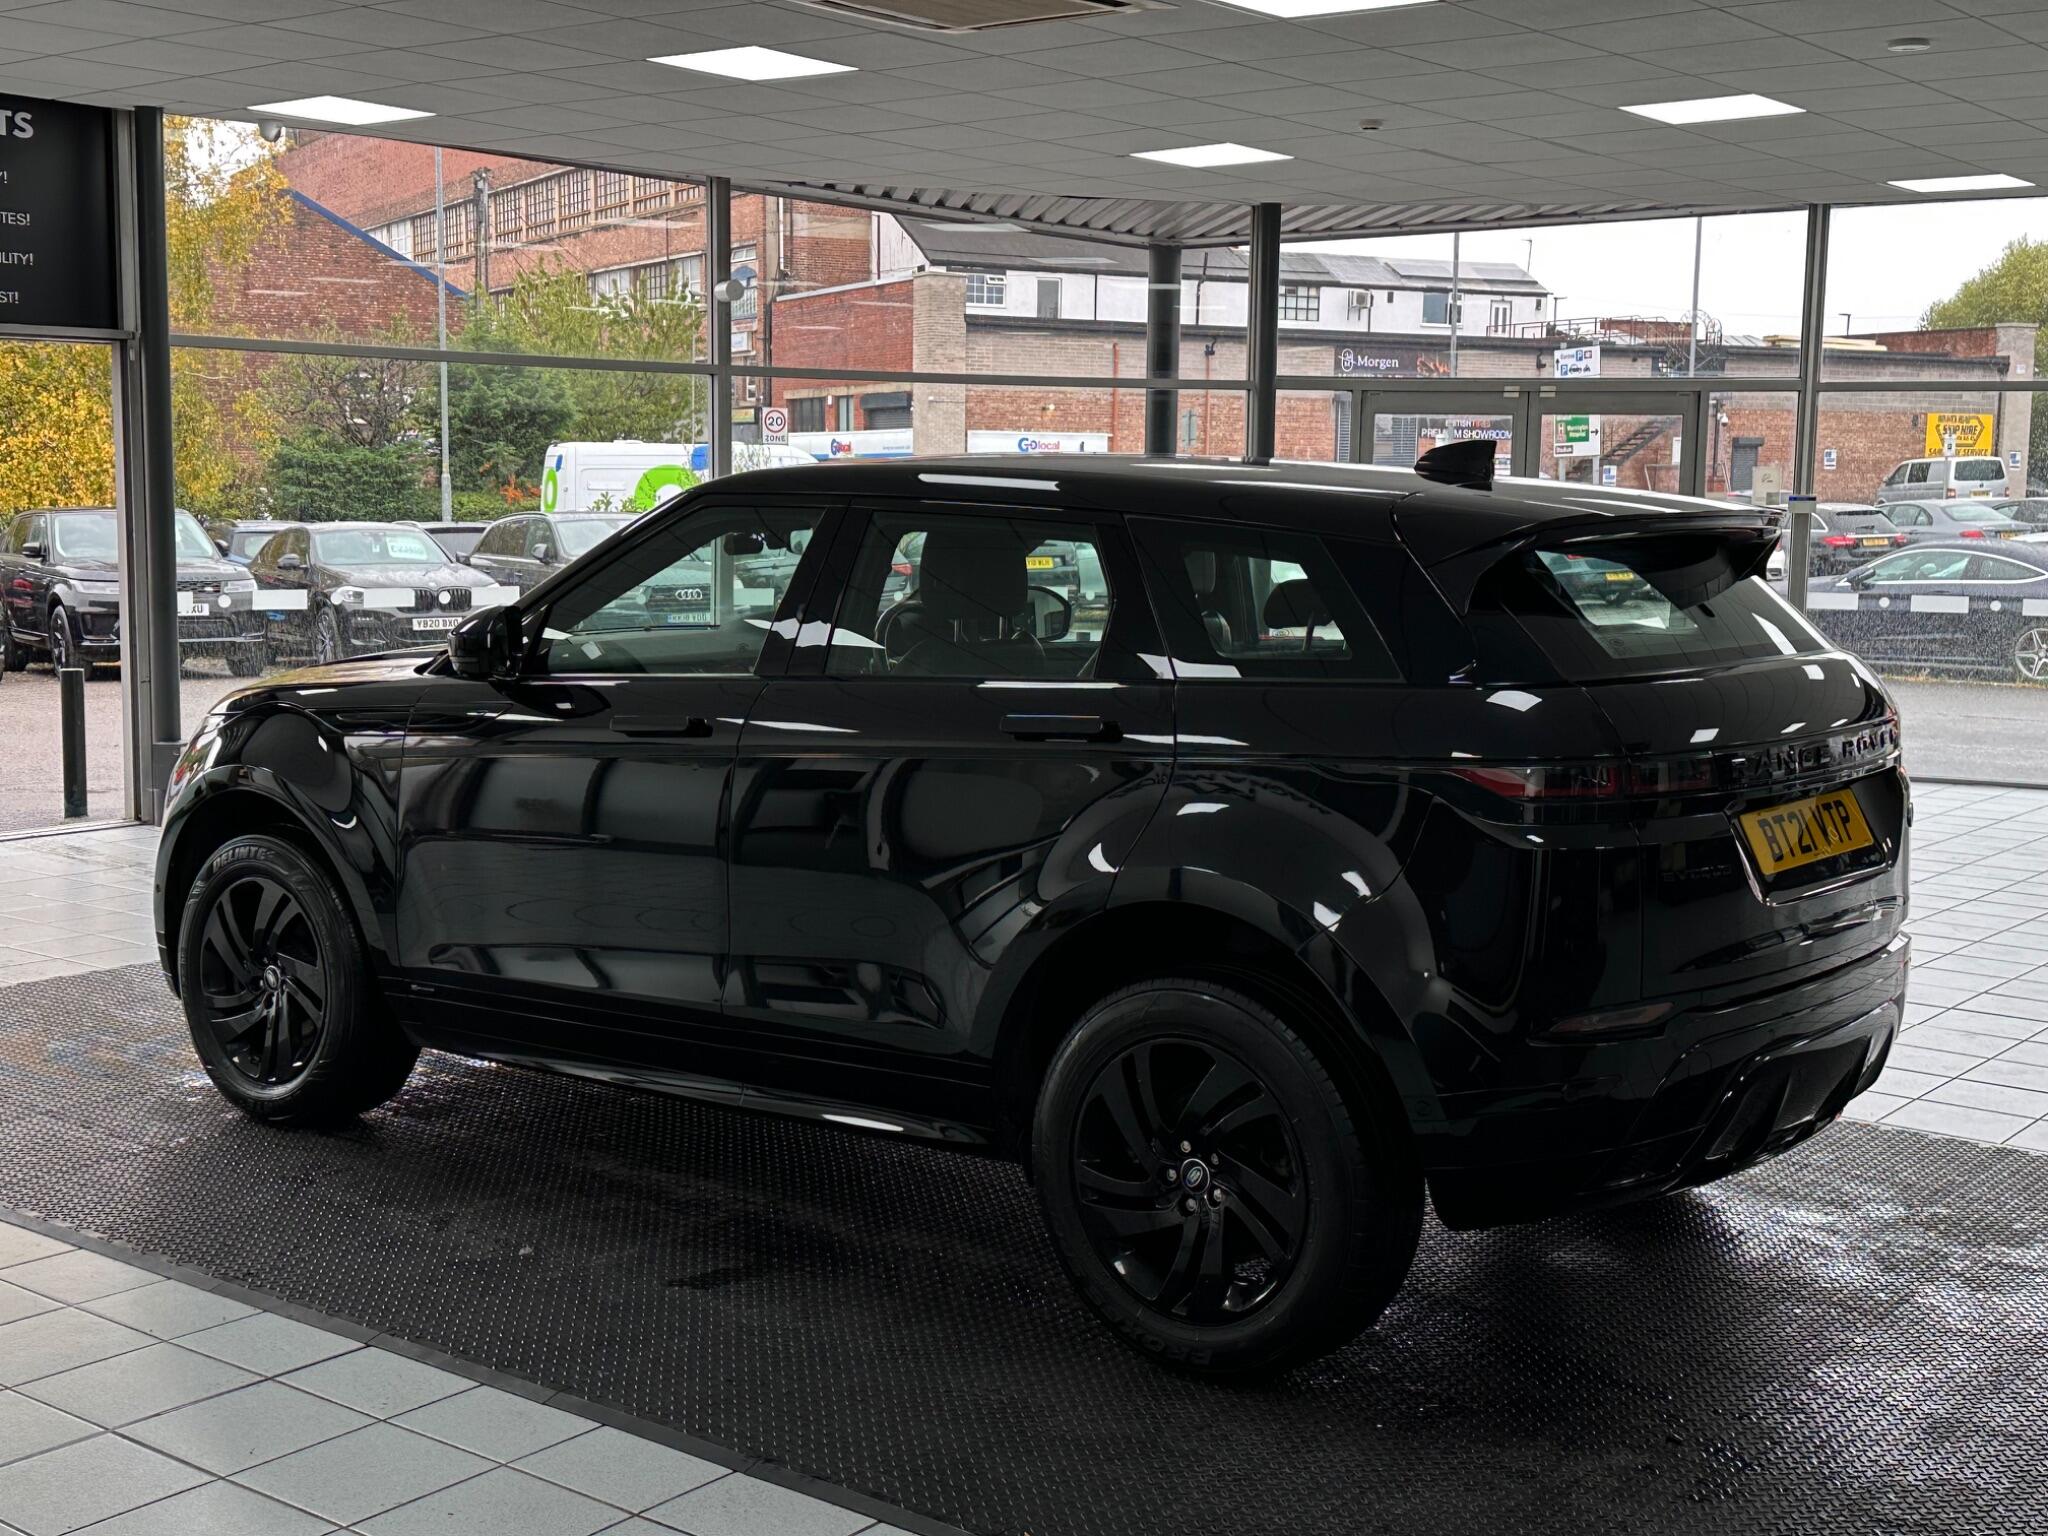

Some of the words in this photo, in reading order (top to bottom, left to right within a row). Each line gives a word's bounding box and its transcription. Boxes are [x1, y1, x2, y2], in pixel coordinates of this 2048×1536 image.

[1357, 355, 1400, 370] Morgen
[767, 415, 783, 427] 20
[764, 434, 786, 442] ZONE
[1462, 428, 1512, 440] SHOWROOM
[1757, 808, 1819, 863] BT21
[1808, 799, 1853, 848] VTP
